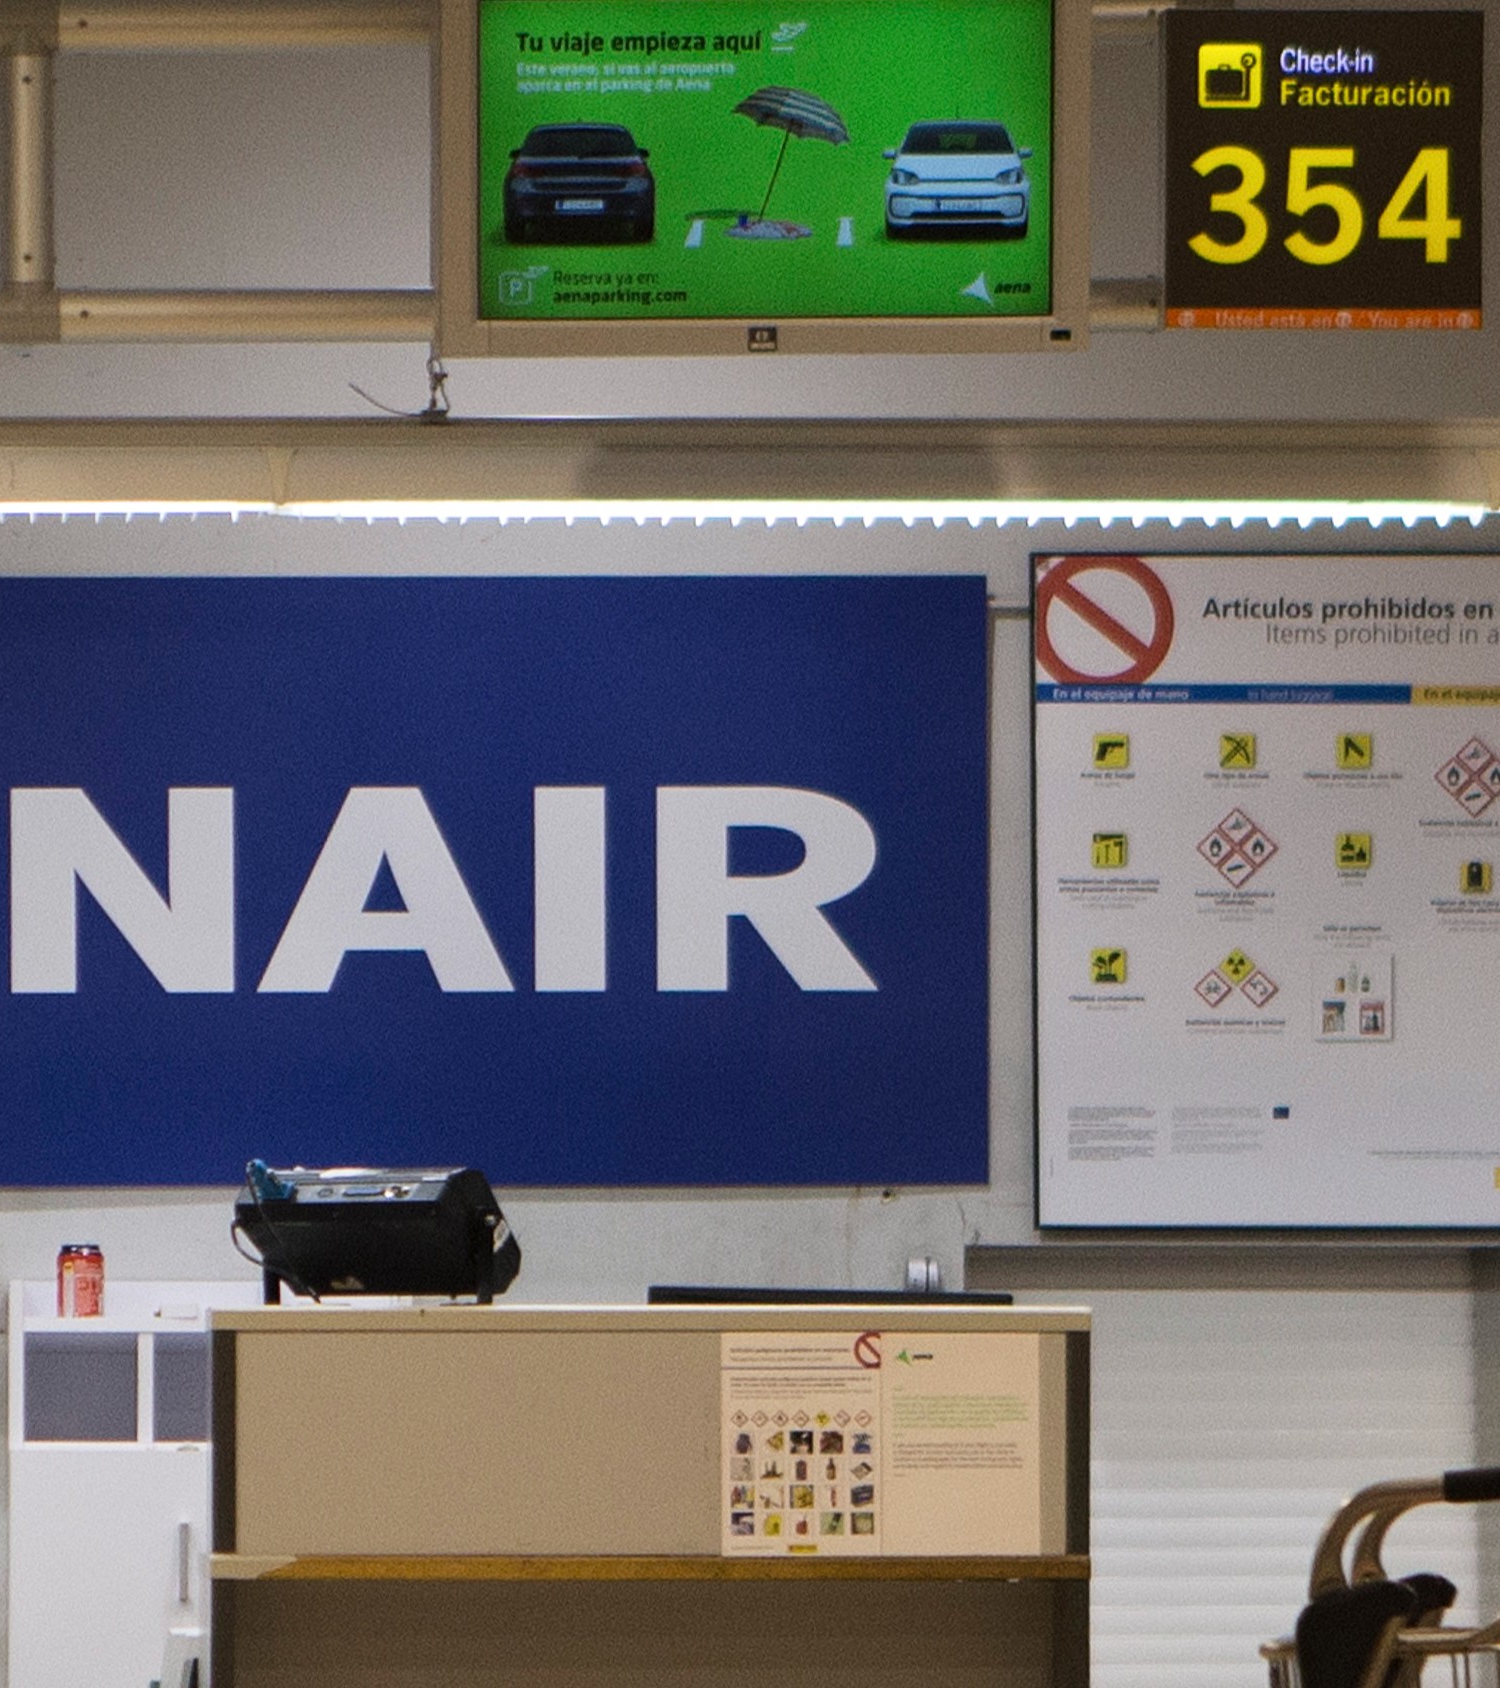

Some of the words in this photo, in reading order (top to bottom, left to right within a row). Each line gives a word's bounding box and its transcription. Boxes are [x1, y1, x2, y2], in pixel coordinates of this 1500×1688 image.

[516, 32, 543, 52] Tu
[549, 32, 604, 56] viaje
[611, 32, 706, 56] empieza
[713, 31, 761, 55] aquí
[1279, 47, 1374, 74] Check-in
[1279, 79, 1451, 107] Facturación
[1188, 145, 1462, 266] 354
[553, 270, 611, 285] Reserva
[615, 274, 633, 289] ya
[994, 283, 1031, 294] aena
[553, 289, 688, 306] aenaparking.com
[1202, 596, 1313, 619] Artículos
[1321, 597, 1455, 624] prohibidos
[1463, 602, 1494, 620] en
[1266, 624, 1327, 645] Items
[1333, 624, 1451, 650] prohibited
[1459, 624, 1479, 645] in
[1053, 689, 1069, 701] En
[1074, 688, 1083, 701] el
[1085, 688, 1135, 704] equipaje
